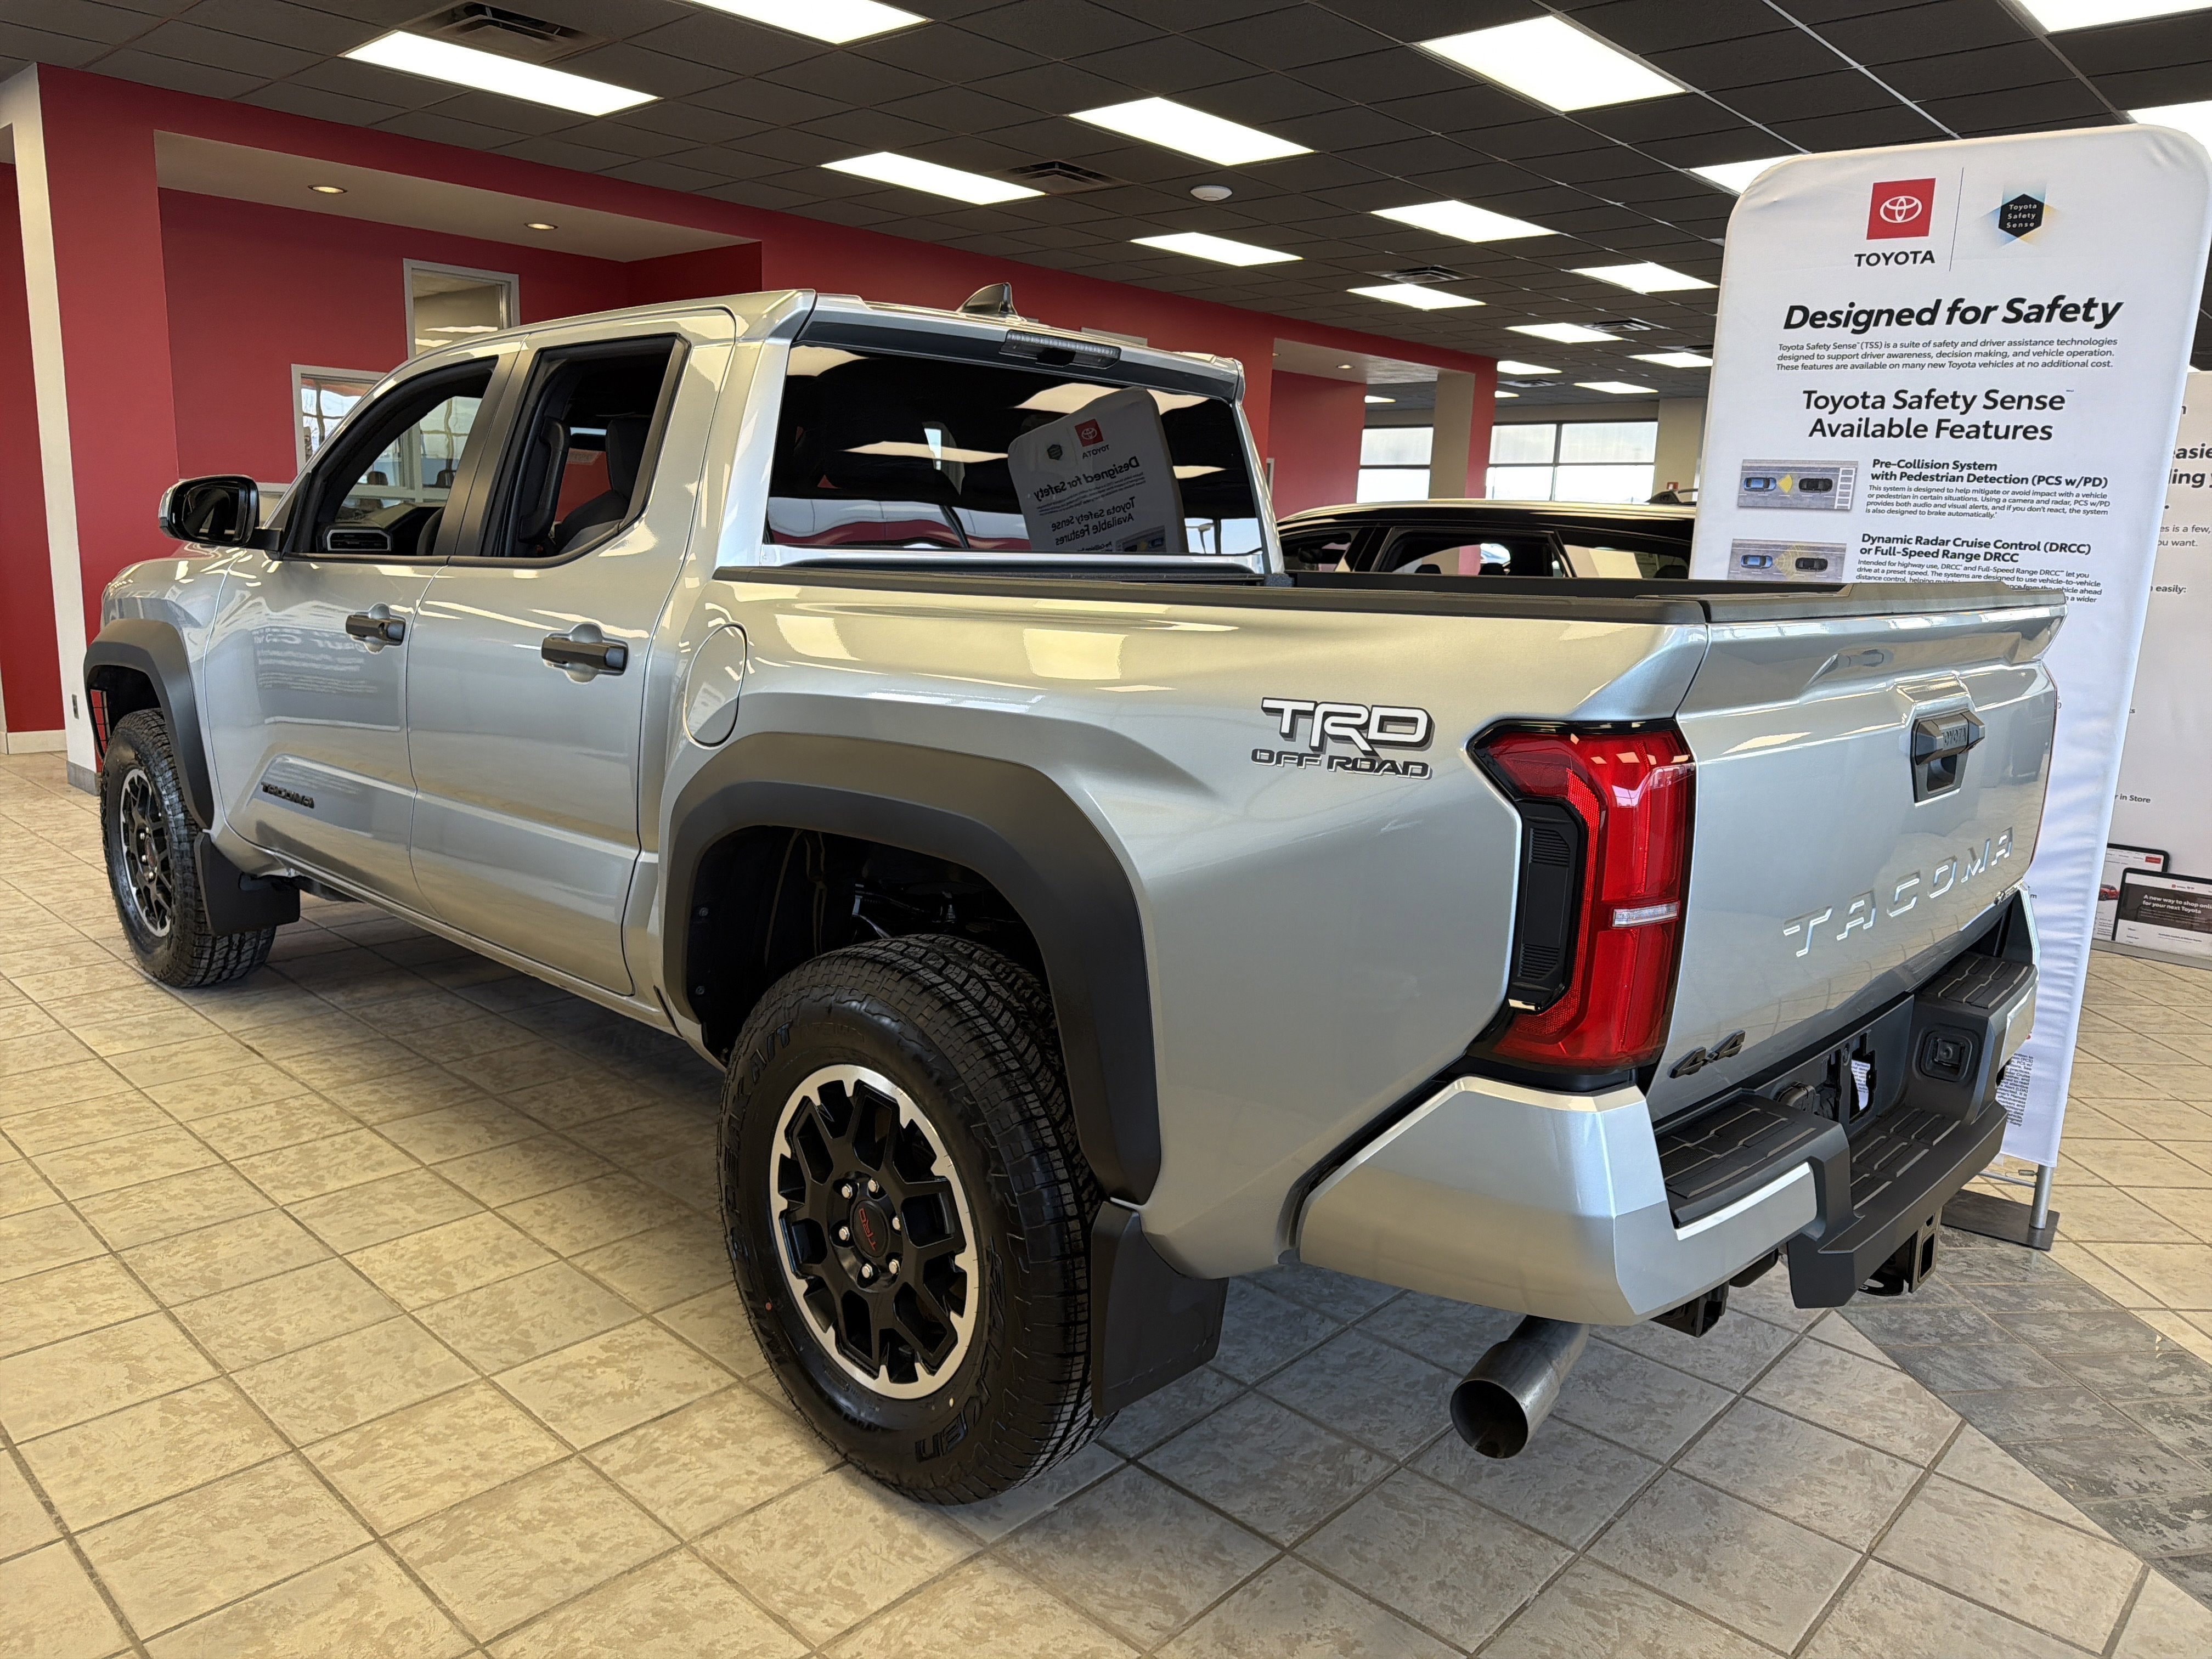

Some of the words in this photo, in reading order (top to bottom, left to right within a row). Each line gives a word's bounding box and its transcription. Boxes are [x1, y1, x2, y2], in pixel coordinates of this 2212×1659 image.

[2008, 203, 2038, 211] Toyota
[2007, 212, 2036, 221] Safety
[1854, 250, 1936, 268] TOYOTA
[1783, 298, 1942, 334] Designed
[1945, 297, 1999, 325] for
[2001, 295, 2124, 329] Safety
[1778, 343, 1804, 352] Toyota
[1805, 342, 1831, 352] Safety
[1860, 341, 1882, 350] (TSS)
[1932, 340, 1959, 349] safety
[1960, 338, 1978, 347] and
[1979, 338, 2006, 347] driver
[2007, 338, 2055, 346] assistance
[2056, 337, 2118, 347] technologies
[1778, 352, 1815, 362] designed
[1826, 352, 1860, 361] support
[1974, 349, 2010, 359] making,
[2012, 348, 2030, 357] and
[2032, 348, 2064, 357] vehicle
[2066, 348, 2114, 358] operation.
[1849, 361, 1887, 369] available
[1948, 360, 1976, 370] Toyota
[2041, 359, 2089, 368] additional
[1802, 390, 1886, 415] Toyota
[1892, 388, 1978, 415] Safety
[1808, 417, 1928, 438] Available
[1935, 419, 2053, 441] Features
[1872, 459, 1949, 470] Pre-Collision
[1951, 460, 1997, 472] System
[1871, 470, 1897, 481] with
[1899, 471, 1964, 482] Pedestrian
[1966, 473, 2029, 484] Detection
[2032, 475, 2062, 486] (PCS
[2064, 476, 2108, 489] w/PD)
[1913, 486, 1945, 494] designed
[1955, 487, 1971, 495] help
[1972, 488, 2001, 496] mitigate
[2032, 489, 2057, 498] impact
[1980, 496, 2001, 504] Using
[1886, 507, 1917, 516] designed
[2191, 524, 2211, 534] few,
[1861, 533, 1913, 545] Dynamic
[1915, 535, 1951, 546] Radar
[1953, 537, 1991, 549] Cruise
[1993, 539, 2041, 551] Control
[2044, 541, 2091, 555] (DRCC)
[2171, 539, 2198, 547] want.
[1874, 546, 1940, 559] Full-Speed
[1942, 549, 1981, 562] Range
[1983, 551, 2019, 563] DRCC
[1897, 561, 1925, 569] highway
[1977, 566, 2015, 574] Full-Speed
[2016, 568, 2038, 576] Range
[1982, 573, 2015, 584] designed
[2038, 577, 2101, 587] vehicle-to-vehicle
[2155, 584, 2186, 594] easily:
[1261, 697, 1435, 759] TRD
[1942, 726, 1967, 747] TOYOTA
[1251, 748, 1322, 769] OFF
[1327, 754, 1433, 780] ROAD
[2129, 794, 2151, 803] Store
[1782, 826, 2013, 957] TACOMA
[2181, 906, 2202, 914] Toyota
[2183, 900, 2199, 908] shop
[859, 1207, 876, 1251] TRD
